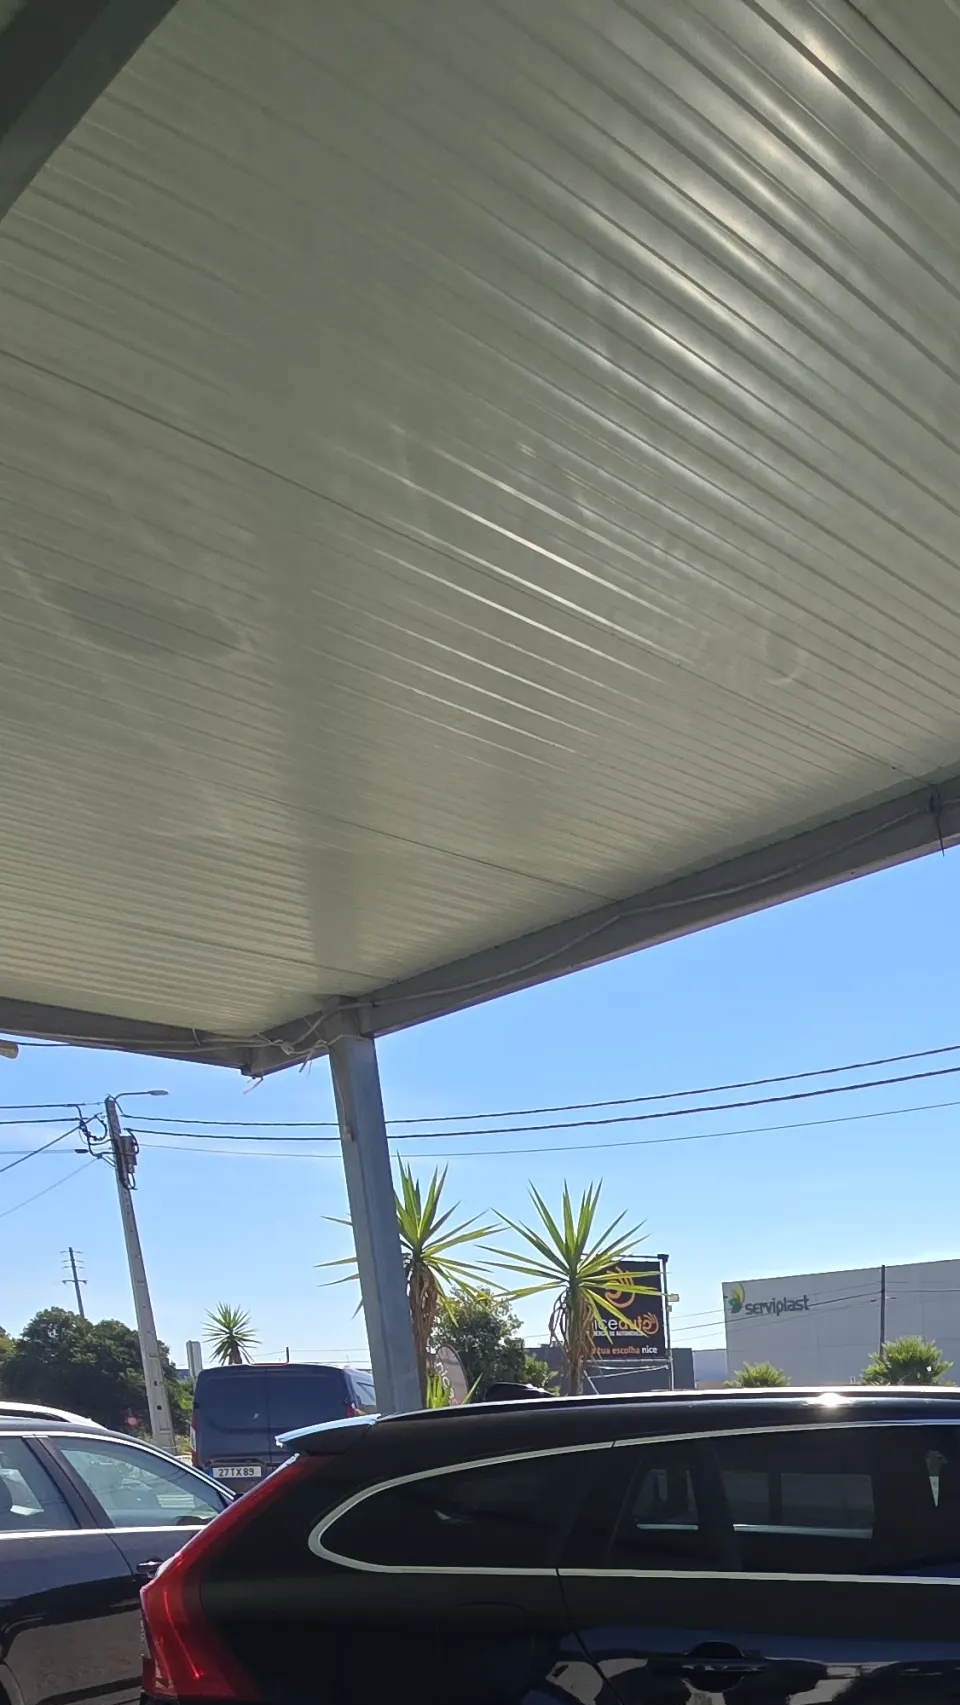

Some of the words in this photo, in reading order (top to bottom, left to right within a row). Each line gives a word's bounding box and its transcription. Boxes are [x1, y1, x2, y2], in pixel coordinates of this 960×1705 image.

[745, 1294, 809, 1316] serviplast
[612, 1345, 640, 1355] escolha
[641, 1344, 658, 1354] nice
